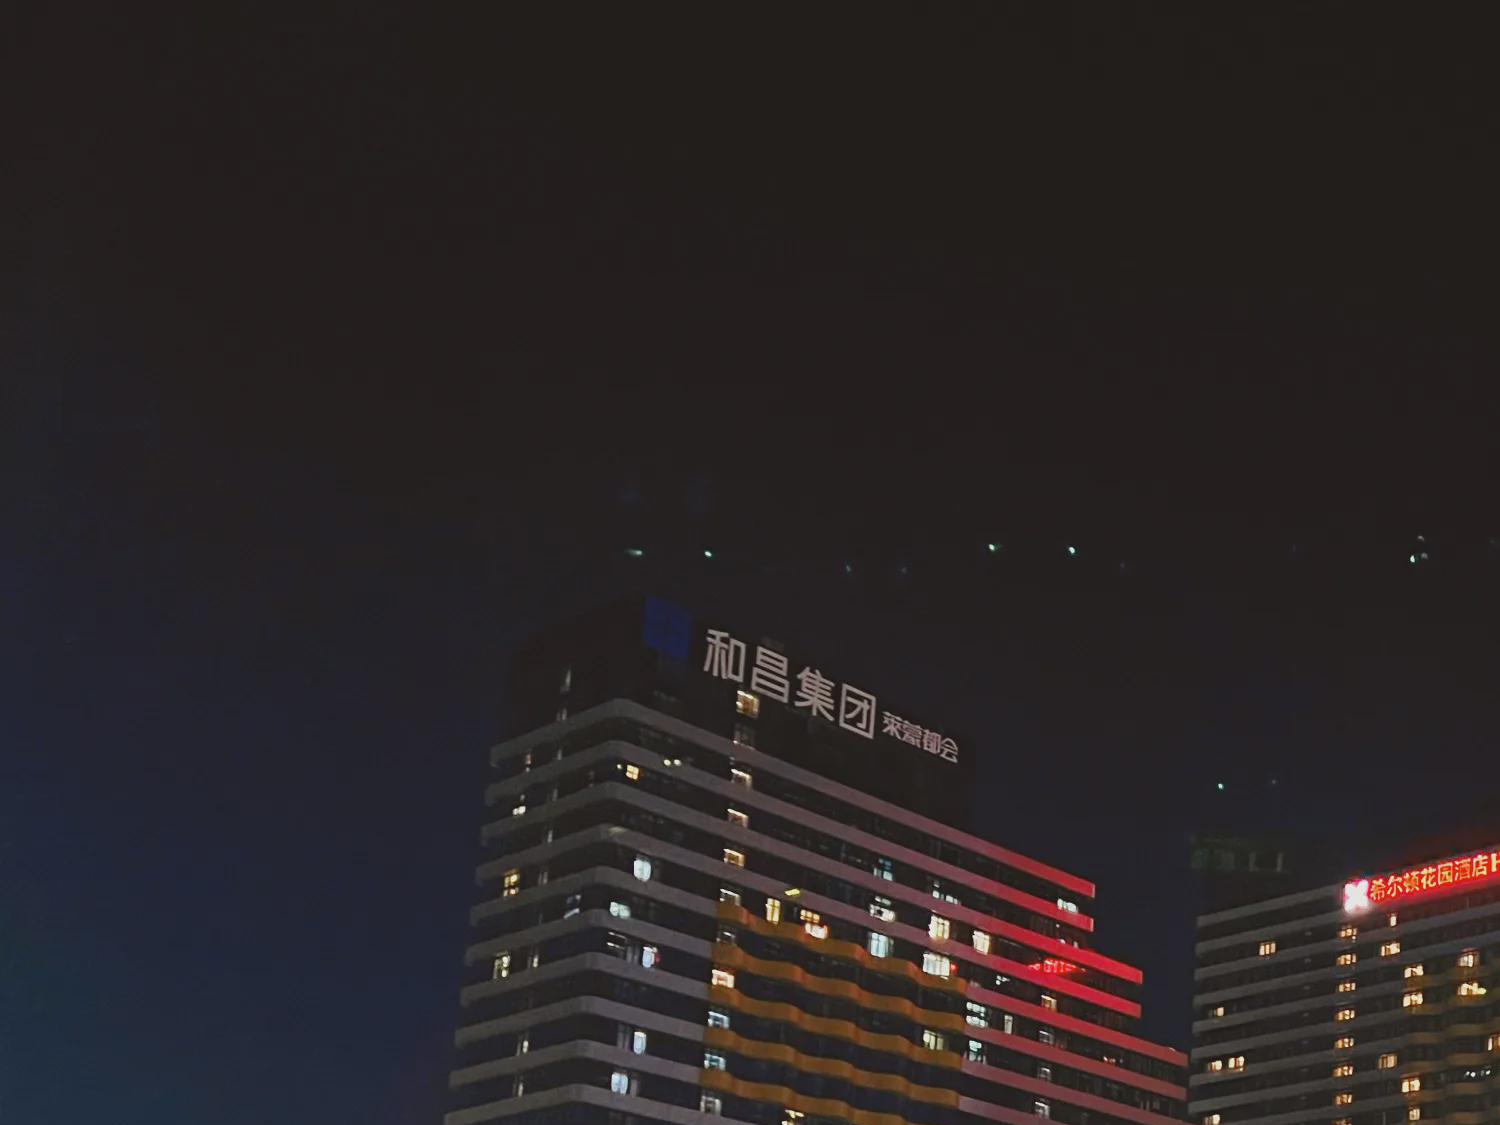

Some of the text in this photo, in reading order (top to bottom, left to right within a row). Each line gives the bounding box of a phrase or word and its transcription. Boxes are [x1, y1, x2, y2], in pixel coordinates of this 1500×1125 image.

[703, 628, 876, 740] 和昌集团
[1369, 854, 1488, 901] 希尔顿花园酒店
